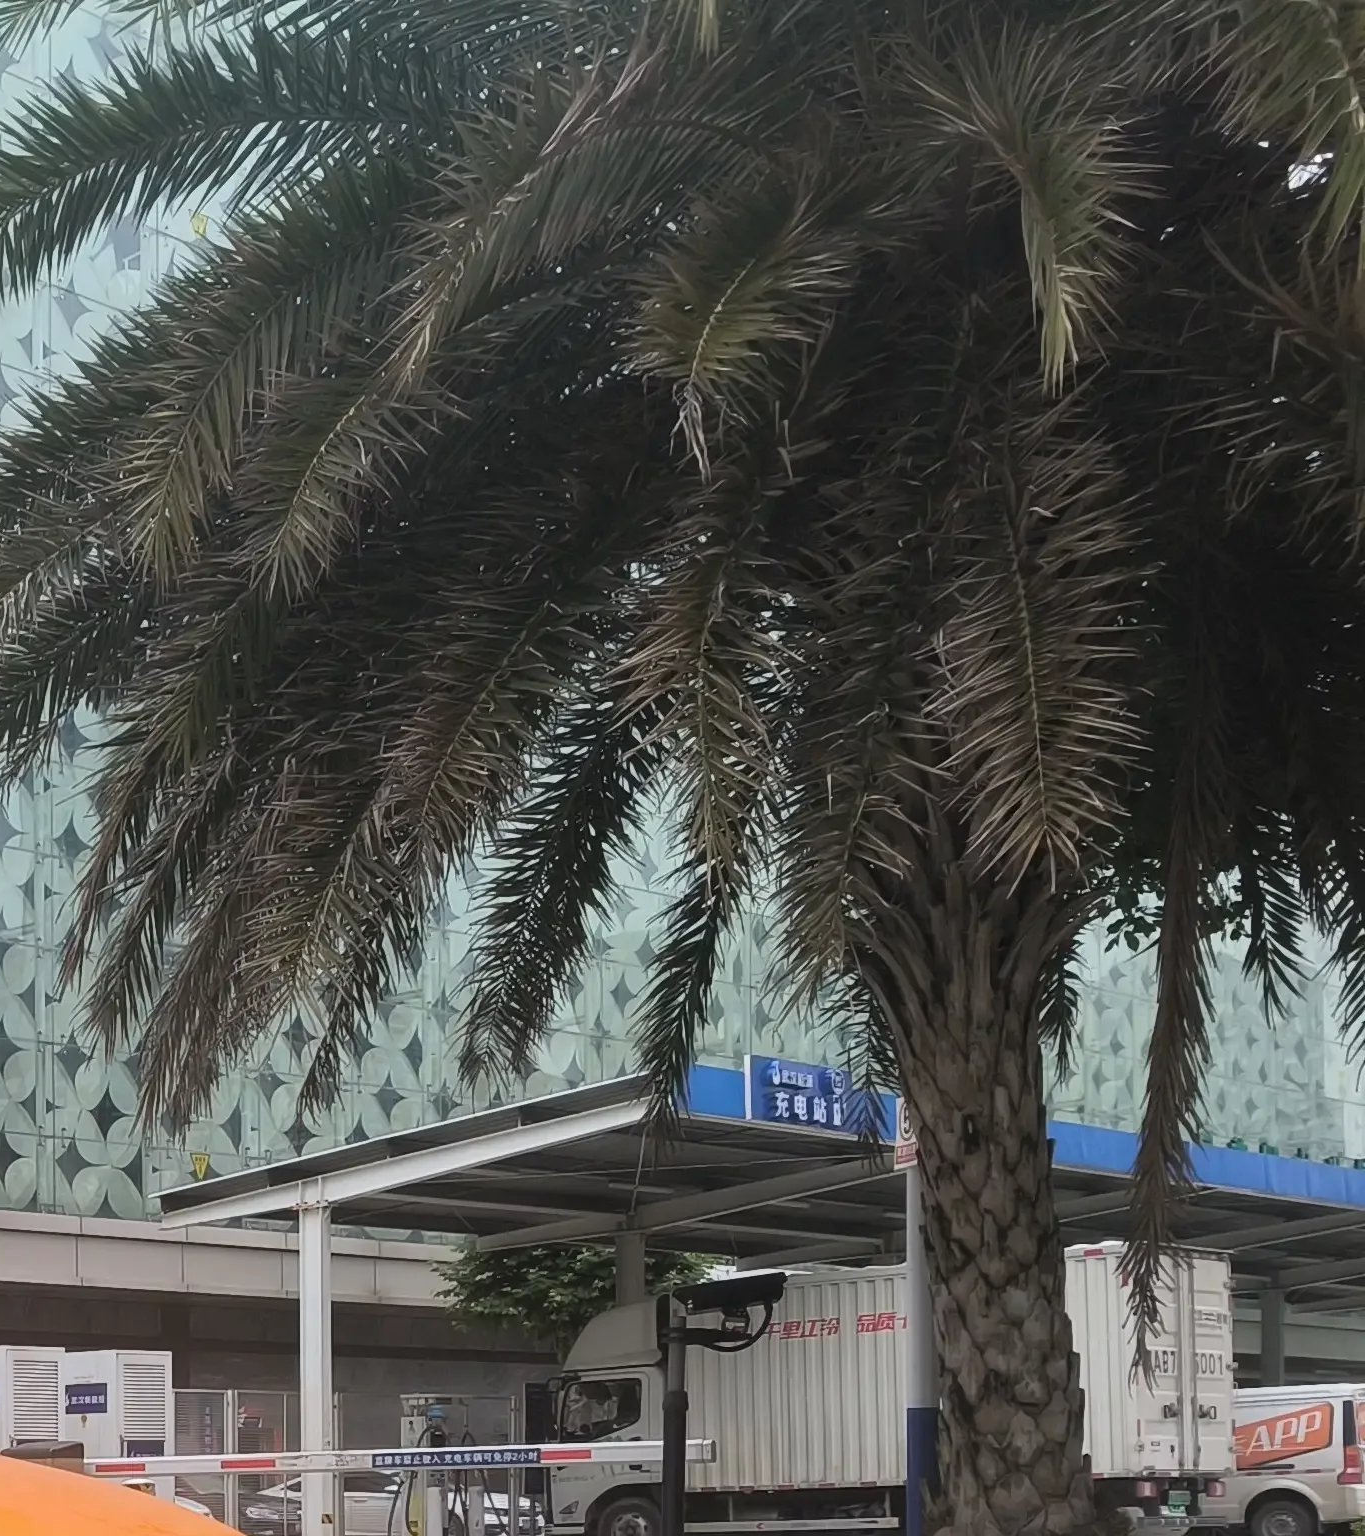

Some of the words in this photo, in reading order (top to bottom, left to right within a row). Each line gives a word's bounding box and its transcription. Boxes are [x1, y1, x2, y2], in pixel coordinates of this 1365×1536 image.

[774, 1091, 827, 1124] 充电站
[1246, 1409, 1323, 1457] APP
